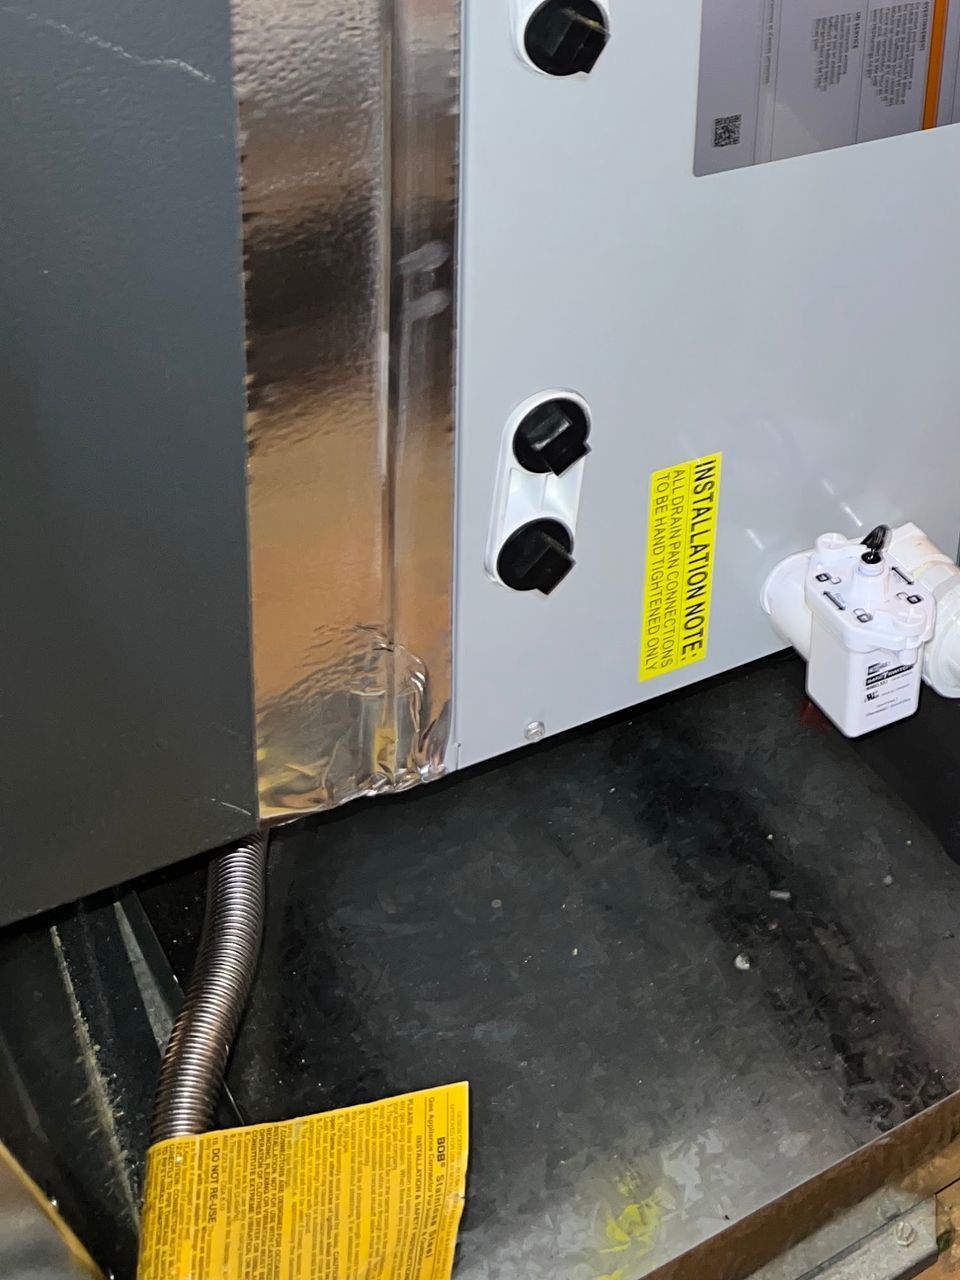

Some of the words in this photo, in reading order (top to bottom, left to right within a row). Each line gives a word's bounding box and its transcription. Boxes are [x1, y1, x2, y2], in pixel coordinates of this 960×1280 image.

[656, 473, 669, 493] TO
[672, 467, 685, 494] ALL
[655, 495, 668, 514] BE
[669, 495, 683, 539] DRAIN
[652, 516, 666, 556] HAND
[685, 459, 716, 600] INSTALLATION
[667, 541, 680, 569] PAN
[647, 557, 664, 635] TIGHTENED
[660, 570, 679, 668] CONNECTIONS
[680, 601, 705, 661] NOTE:
[644, 636, 658, 672] ONLY
[212, 1148, 220, 1162] DO
[211, 1165, 219, 1184] NOT
[208, 1187, 218, 1224] RE-USE
[431, 1174, 444, 1226] Stainless
